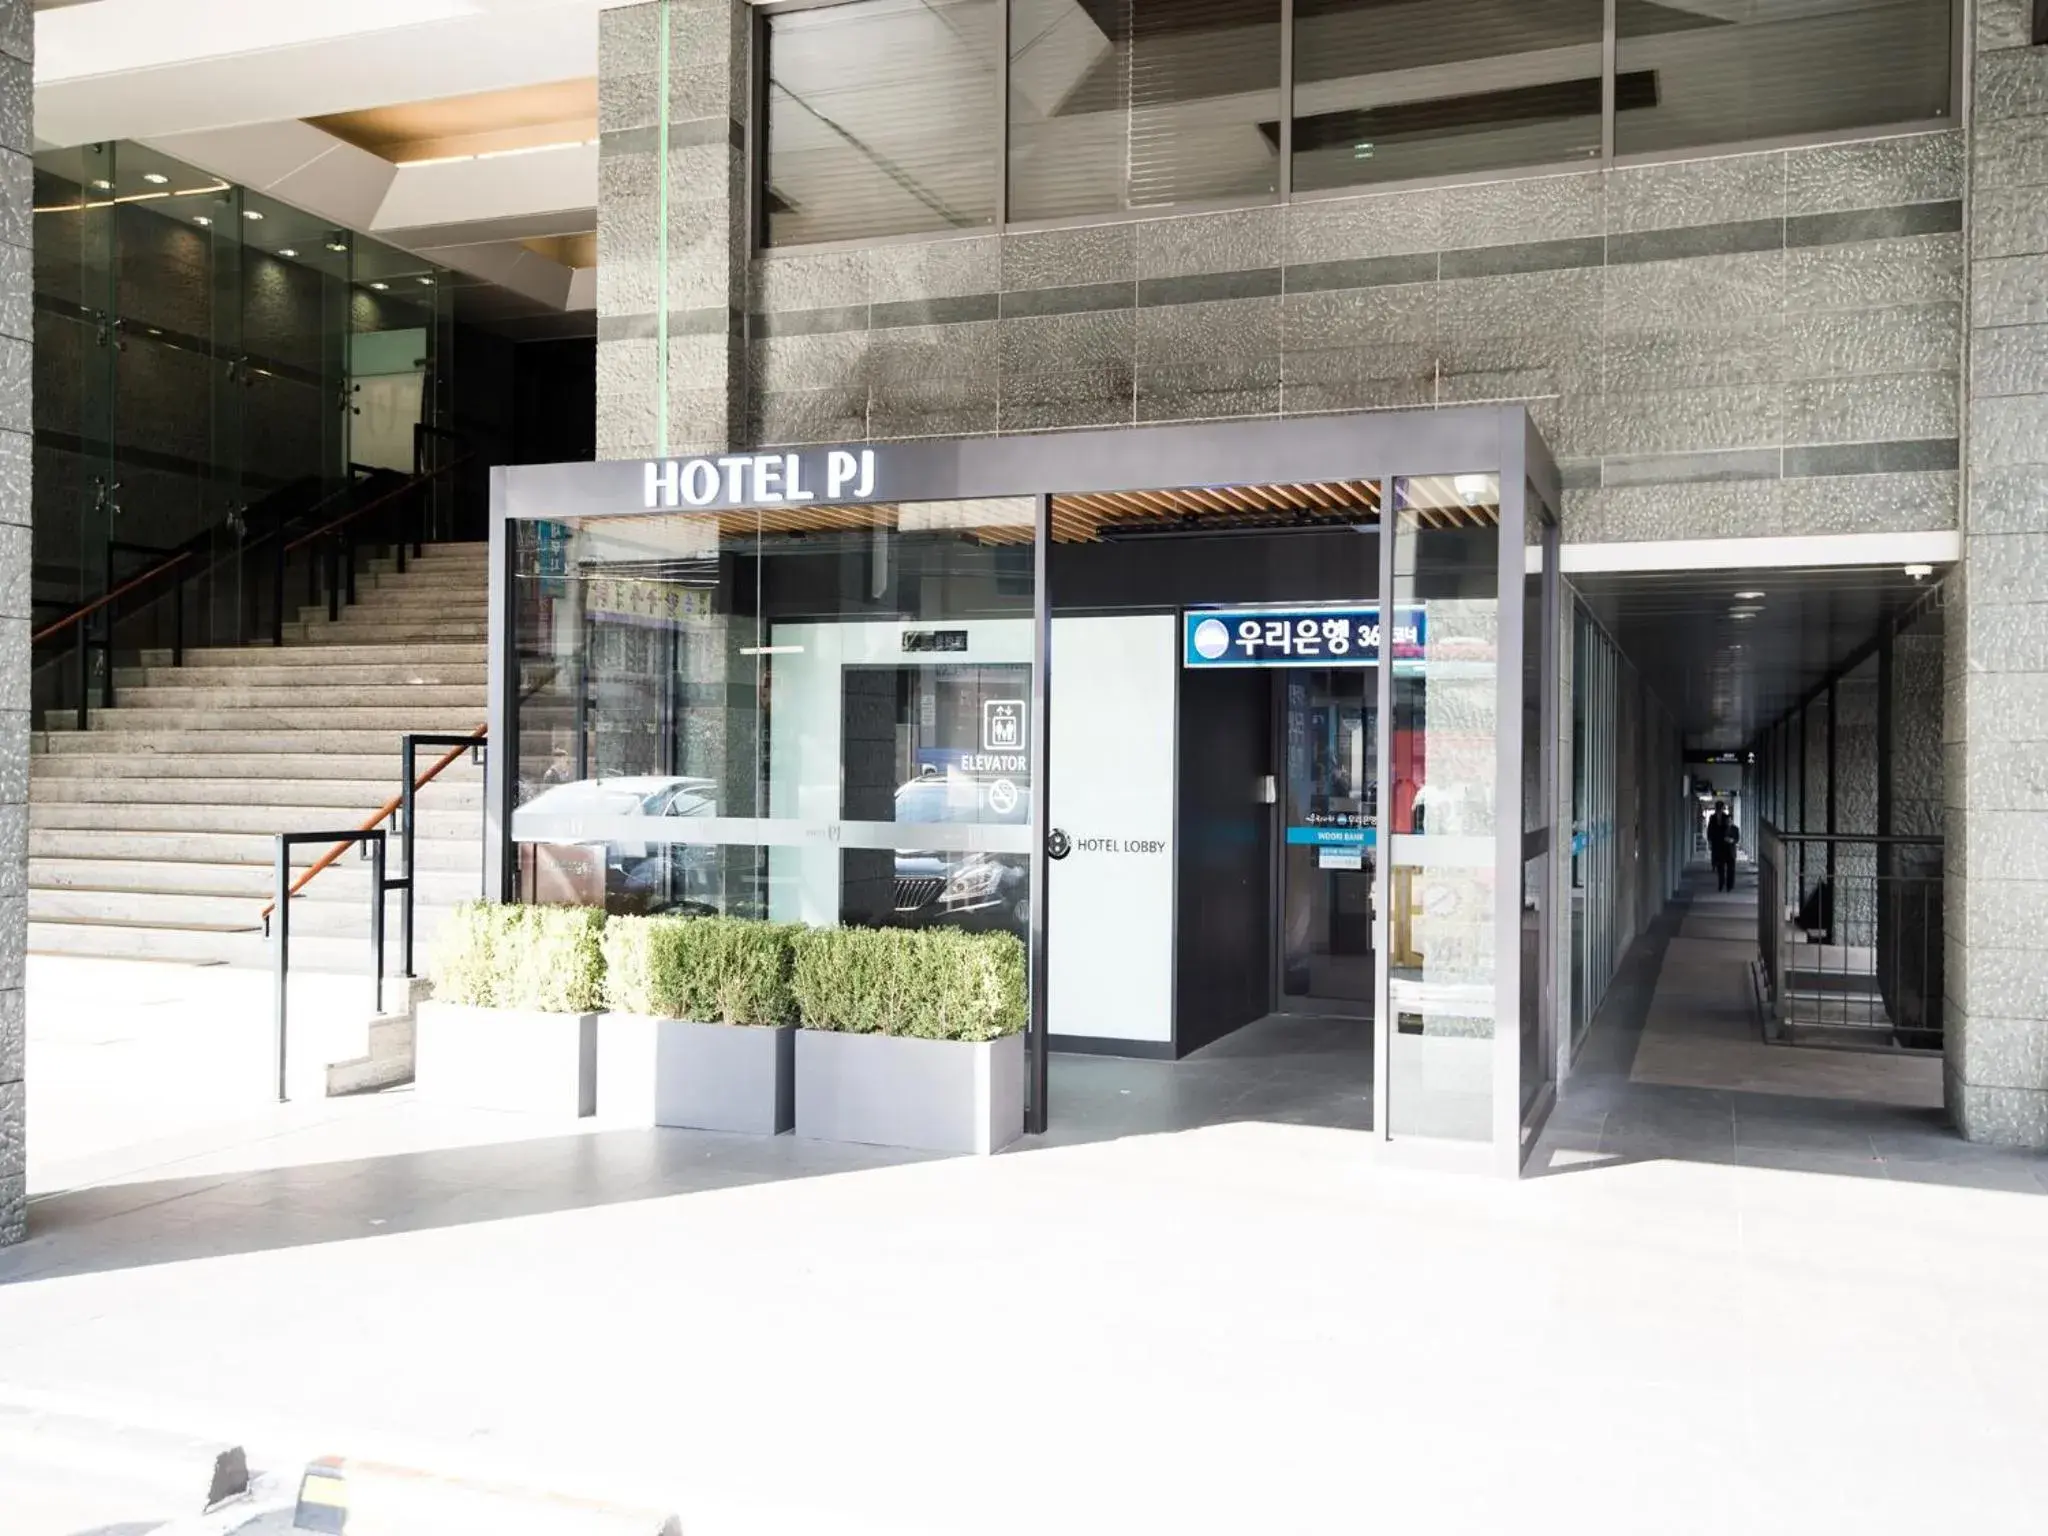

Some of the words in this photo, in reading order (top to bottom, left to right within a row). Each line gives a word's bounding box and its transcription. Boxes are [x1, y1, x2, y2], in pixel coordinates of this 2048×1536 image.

[644, 453, 815, 508] HOTEL
[827, 449, 875, 499] PJ
[1235, 618, 1350, 656] 우리은행
[961, 754, 1027, 772] ELEVATOR
[1344, 832, 1365, 841] BANK
[1077, 839, 1120, 853] HOTEL
[1124, 840, 1166, 854] LOBBY
